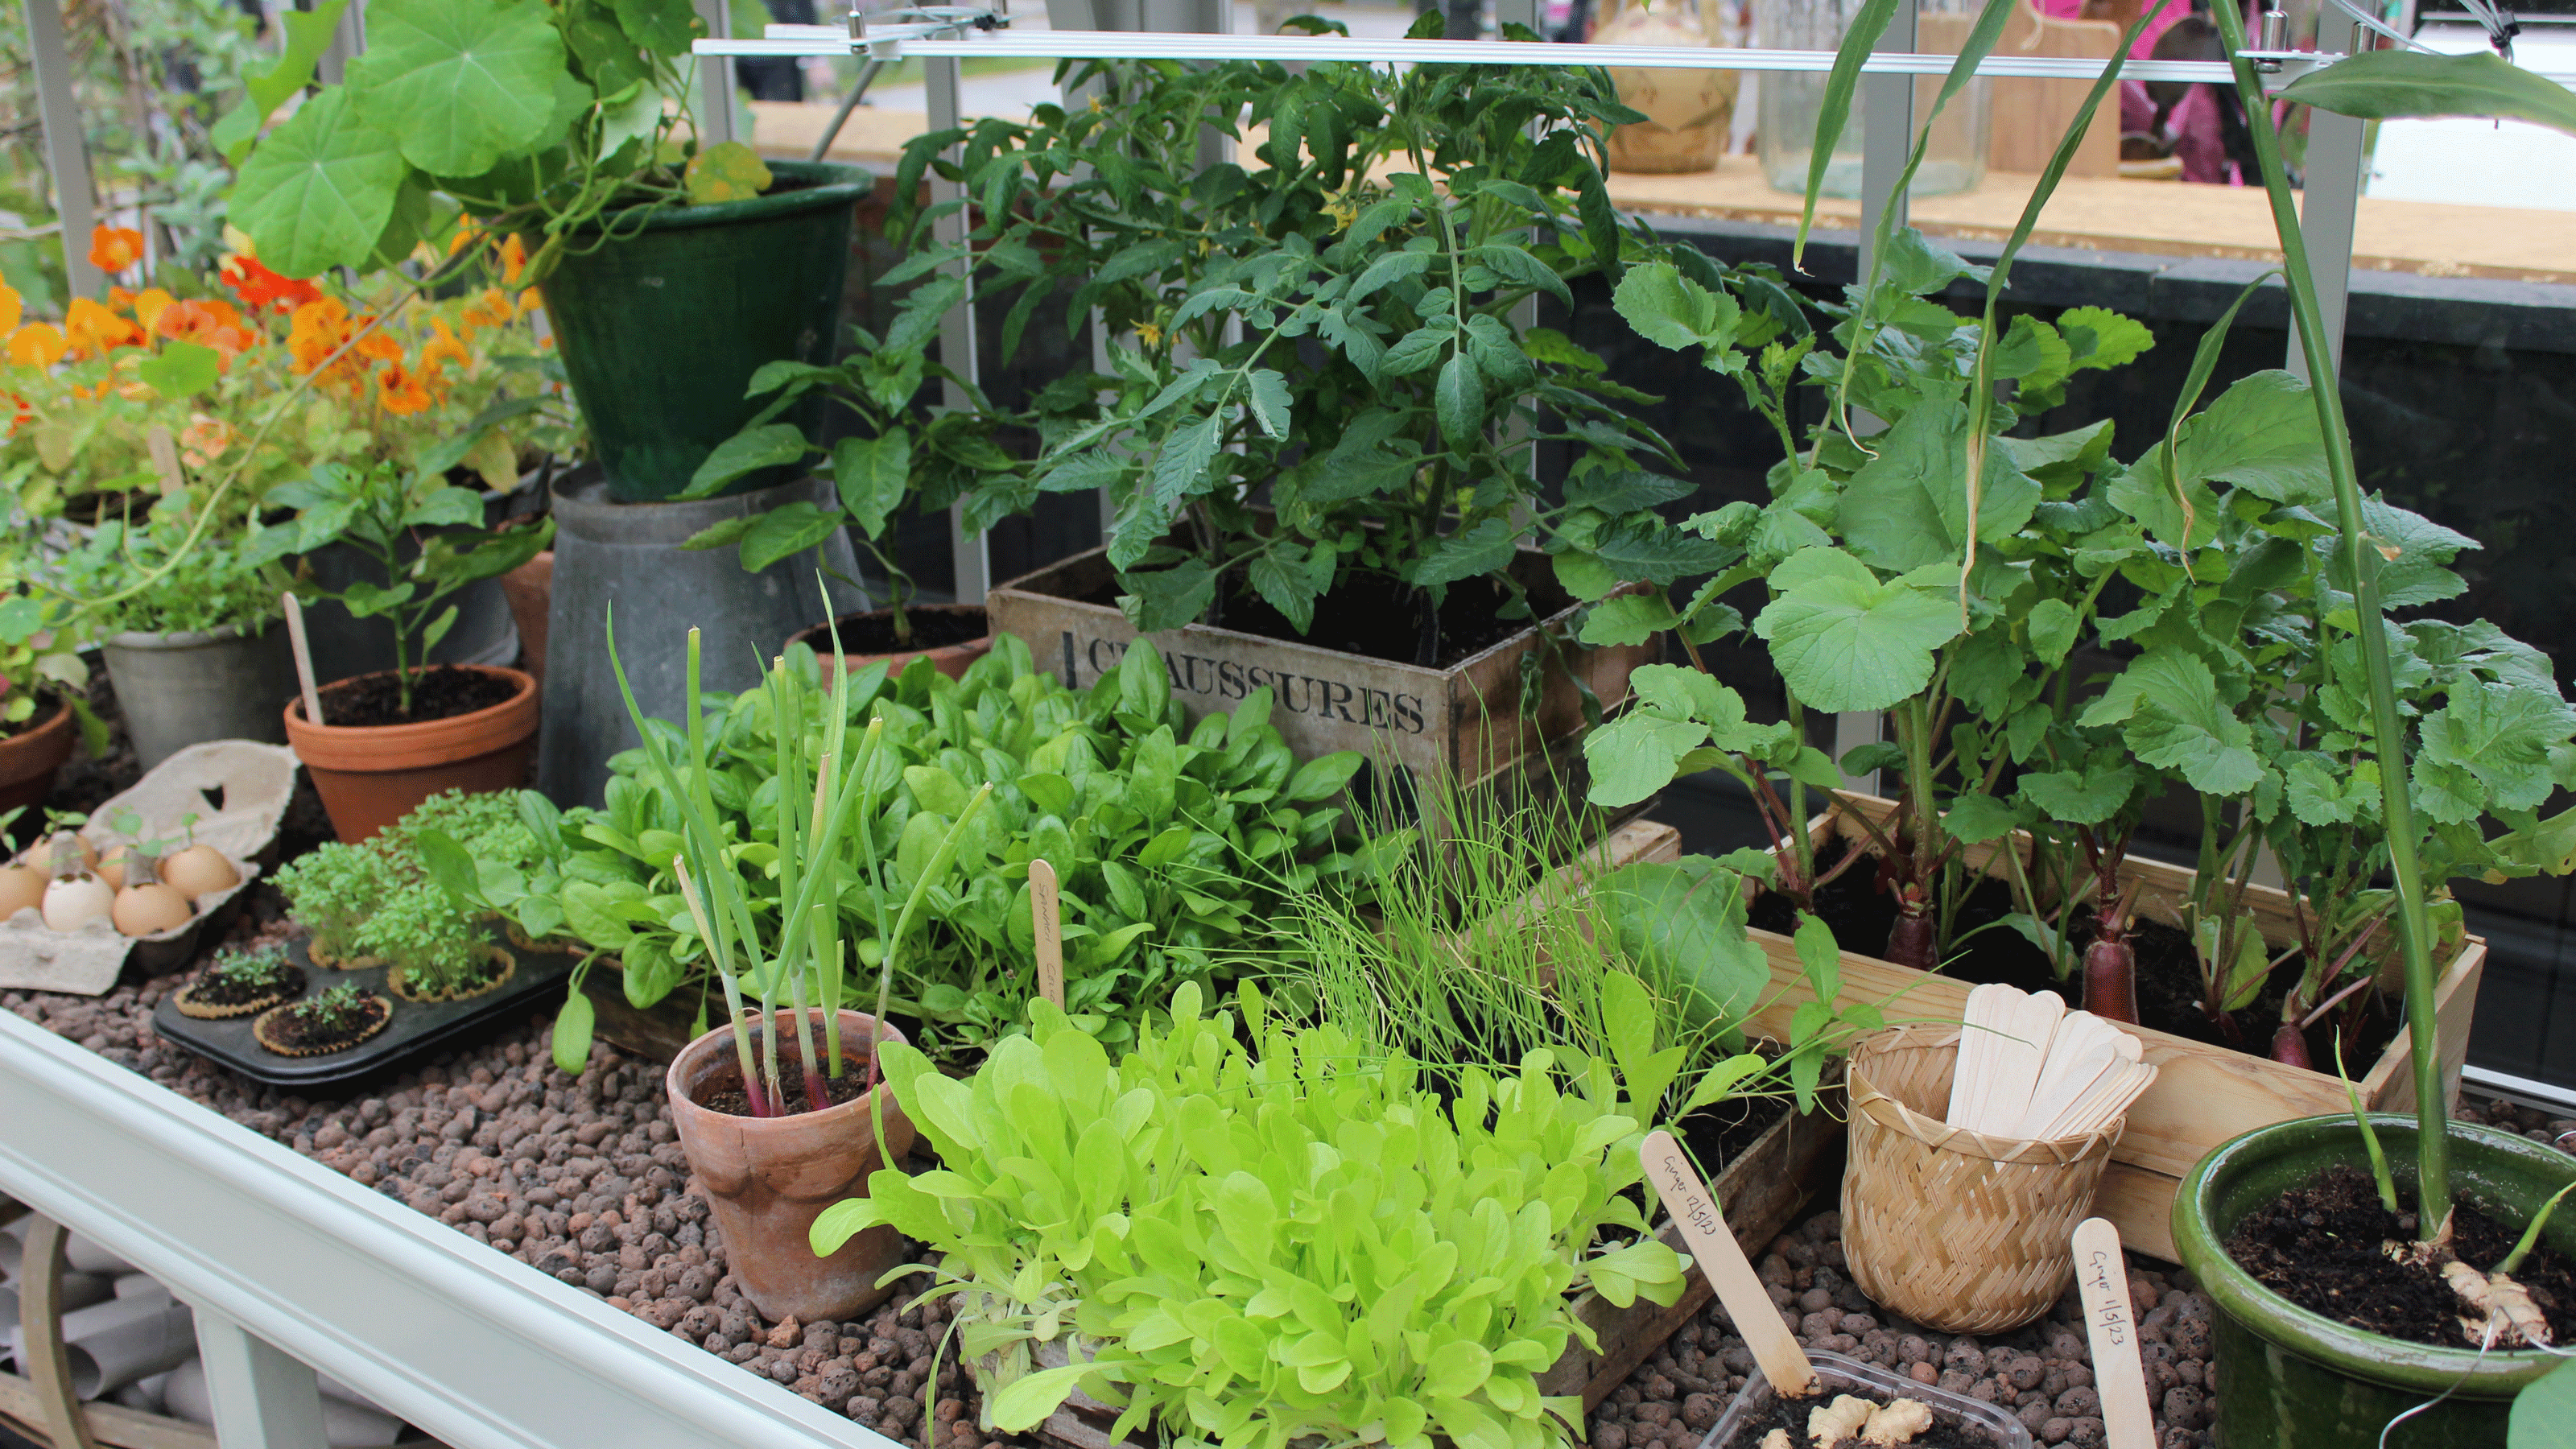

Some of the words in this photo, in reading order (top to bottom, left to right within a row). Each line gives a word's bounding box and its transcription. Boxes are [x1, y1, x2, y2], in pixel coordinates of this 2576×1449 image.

[1088, 638, 1425, 734] CAUSSURES
[1664, 1156, 1686, 1191] Ginger
[1686, 1195, 1716, 1235] 12/5/23
[2087, 1251, 2111, 1291] Ginger
[2099, 1299, 2126, 1345] 1/5/23
